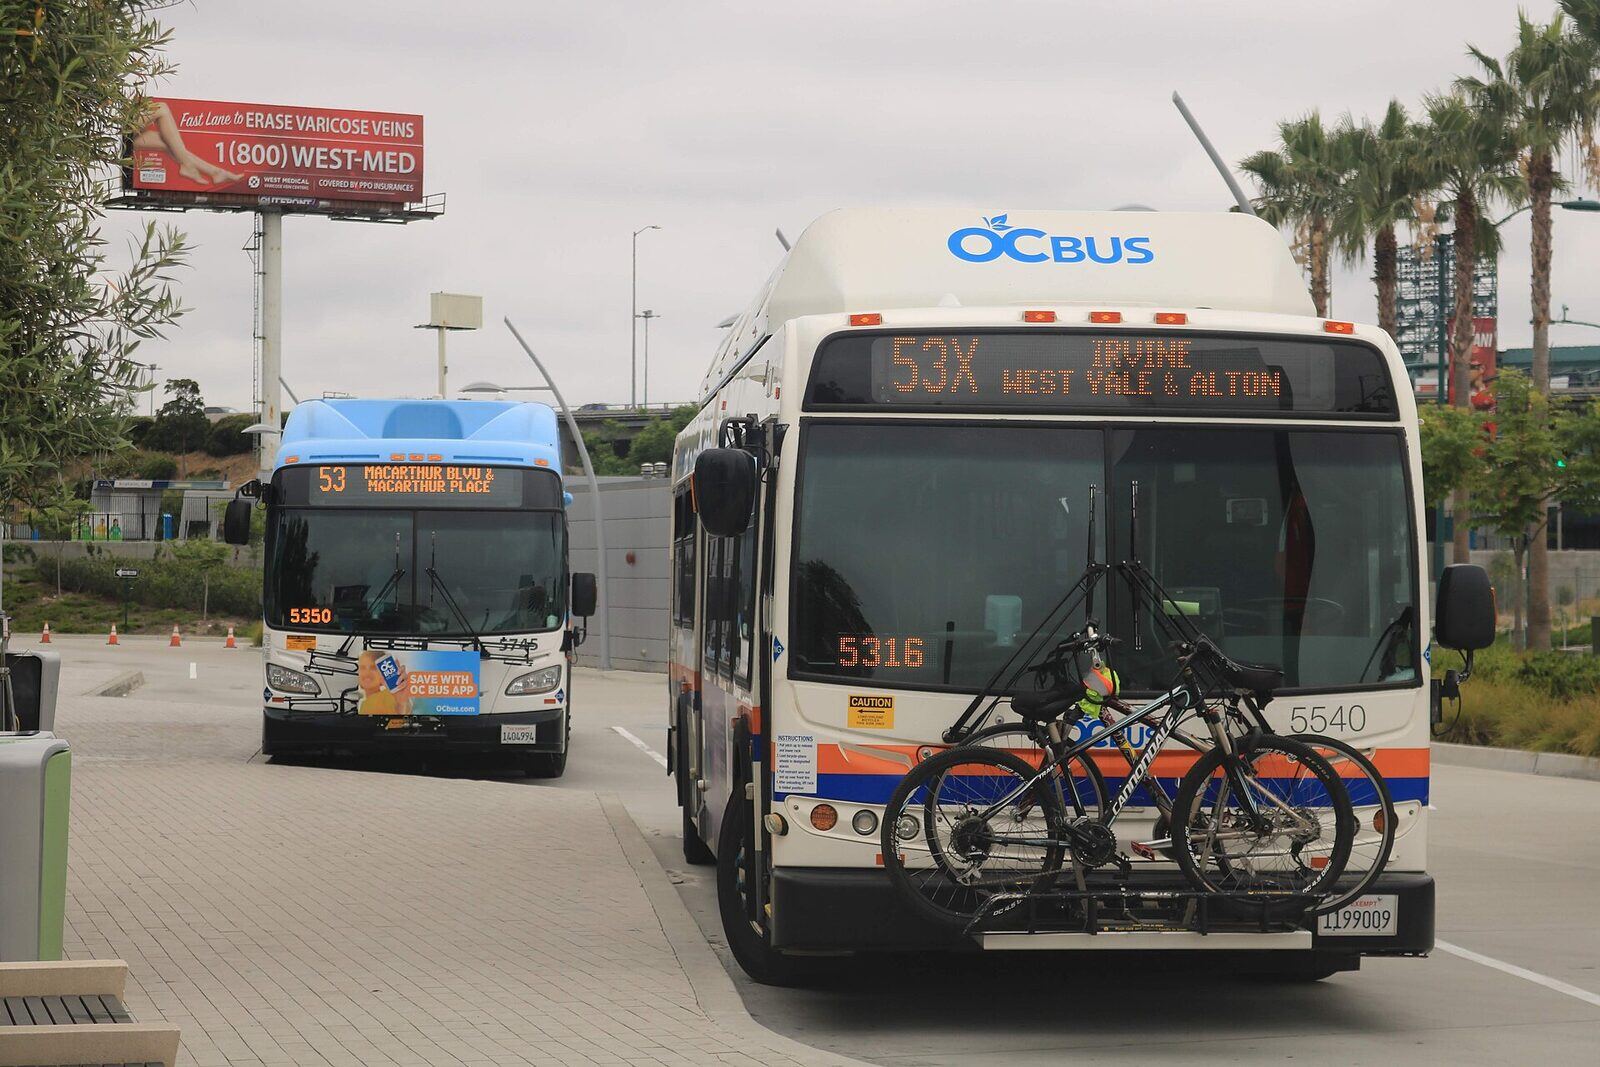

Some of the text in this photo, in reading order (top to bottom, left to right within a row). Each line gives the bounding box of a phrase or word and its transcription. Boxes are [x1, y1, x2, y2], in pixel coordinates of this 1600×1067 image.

[180, 111, 414, 139] Fast Lane to ERASE VARICOSE VEINS
[292, 144, 416, 175] WEST-MED
[282, 177, 309, 185] MEDICAL
[318, 179, 414, 192] COVERED BY PPO INSURANCES
[1092, 340, 1192, 368] IRVINE
[893, 337, 979, 393] 53X
[1003, 369, 1280, 396] WEST YALE & ALTON
[319, 466, 347, 492] 53
[364, 466, 443, 480] MACARTHUR
[485, 468, 494, 480] &
[367, 480, 491, 493] MACARTHUR PLACE
[290, 608, 331, 623] 5350
[840, 637, 923, 667] 5316
[383, 666, 396, 677] BUS
[410, 674, 469, 684] SAVE WITH
[410, 685, 474, 695] OC BUS APP
[436, 705, 475, 713] OCbus.com
[851, 697, 891, 707] CAUTION
[1290, 705, 1366, 733] 5540
[1302, 884, 1312, 894] DC
[1324, 910, 1391, 929] 1199009
